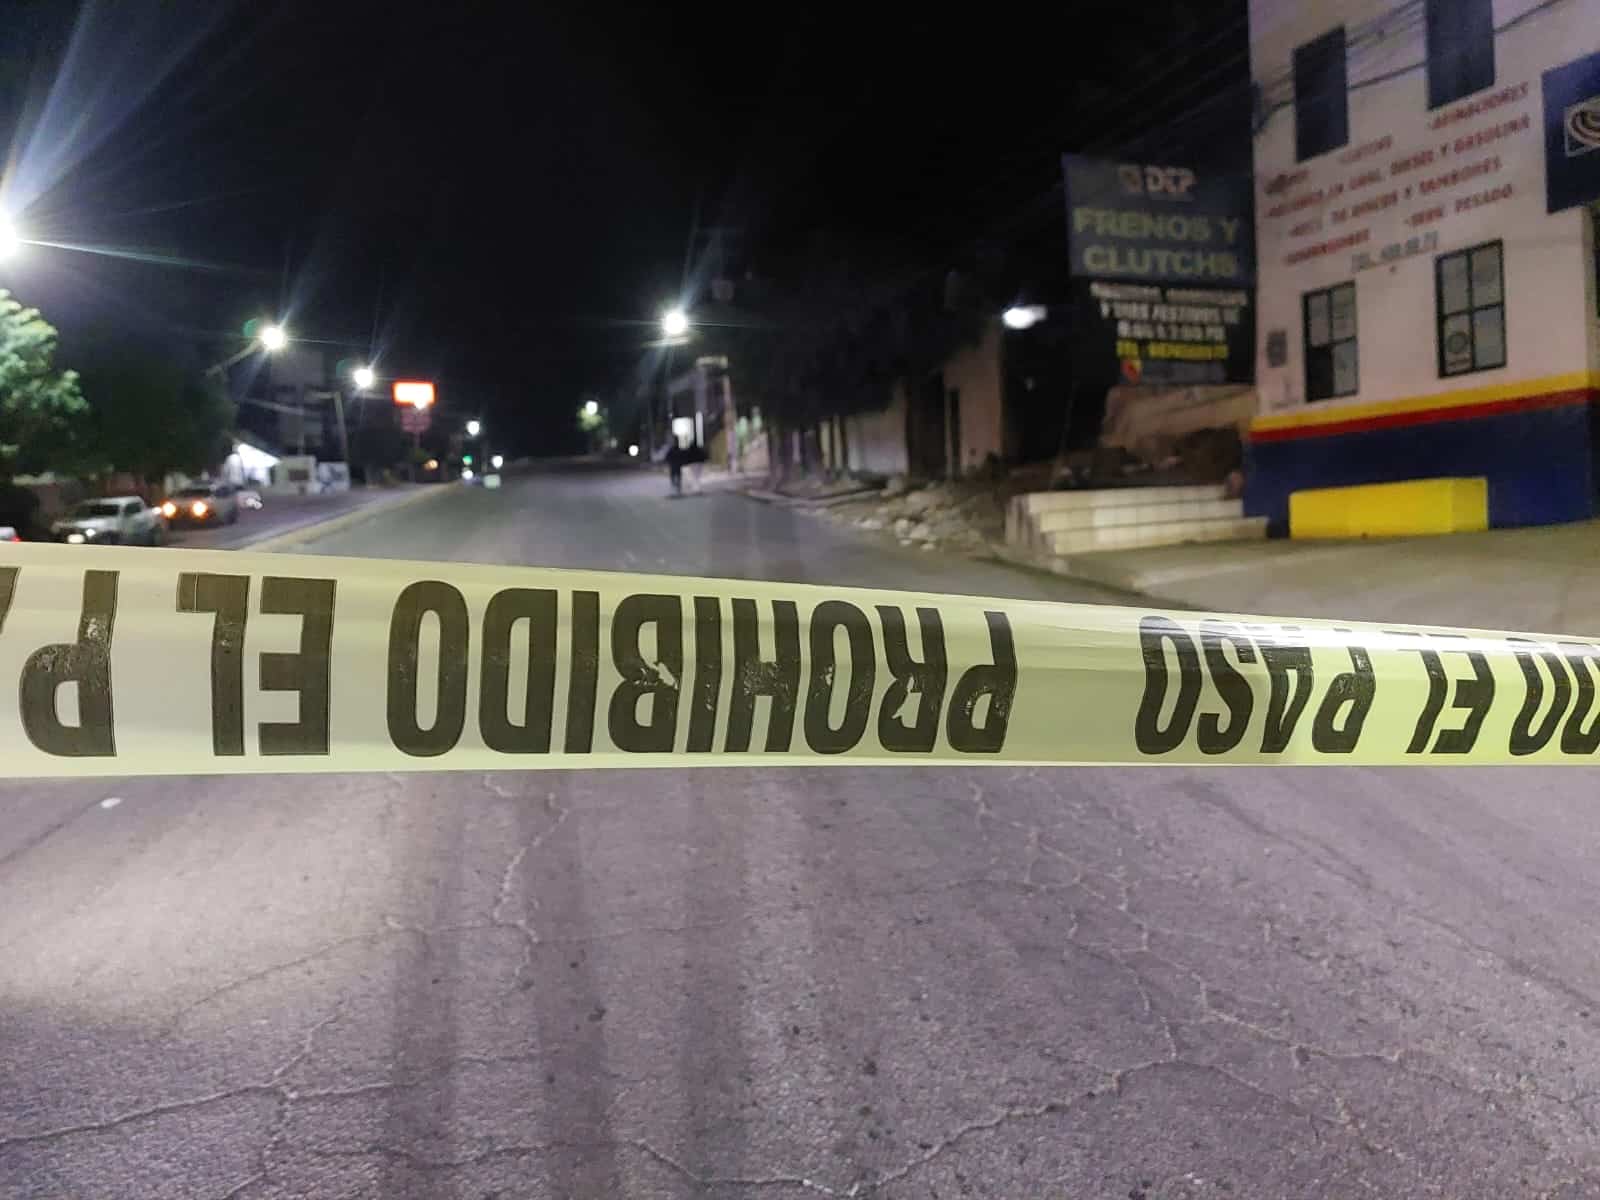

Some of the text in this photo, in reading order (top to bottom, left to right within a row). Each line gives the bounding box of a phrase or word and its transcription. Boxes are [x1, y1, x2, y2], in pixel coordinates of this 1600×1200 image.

[1072, 206, 1240, 243] FRENOS Y
[1082, 244, 1237, 278] CLUTCHS
[176, 571, 338, 756] EL
[386, 579, 1017, 757] PROHIBIDO
[1134, 615, 1376, 755] PASO
[1381, 631, 1495, 754] EL
